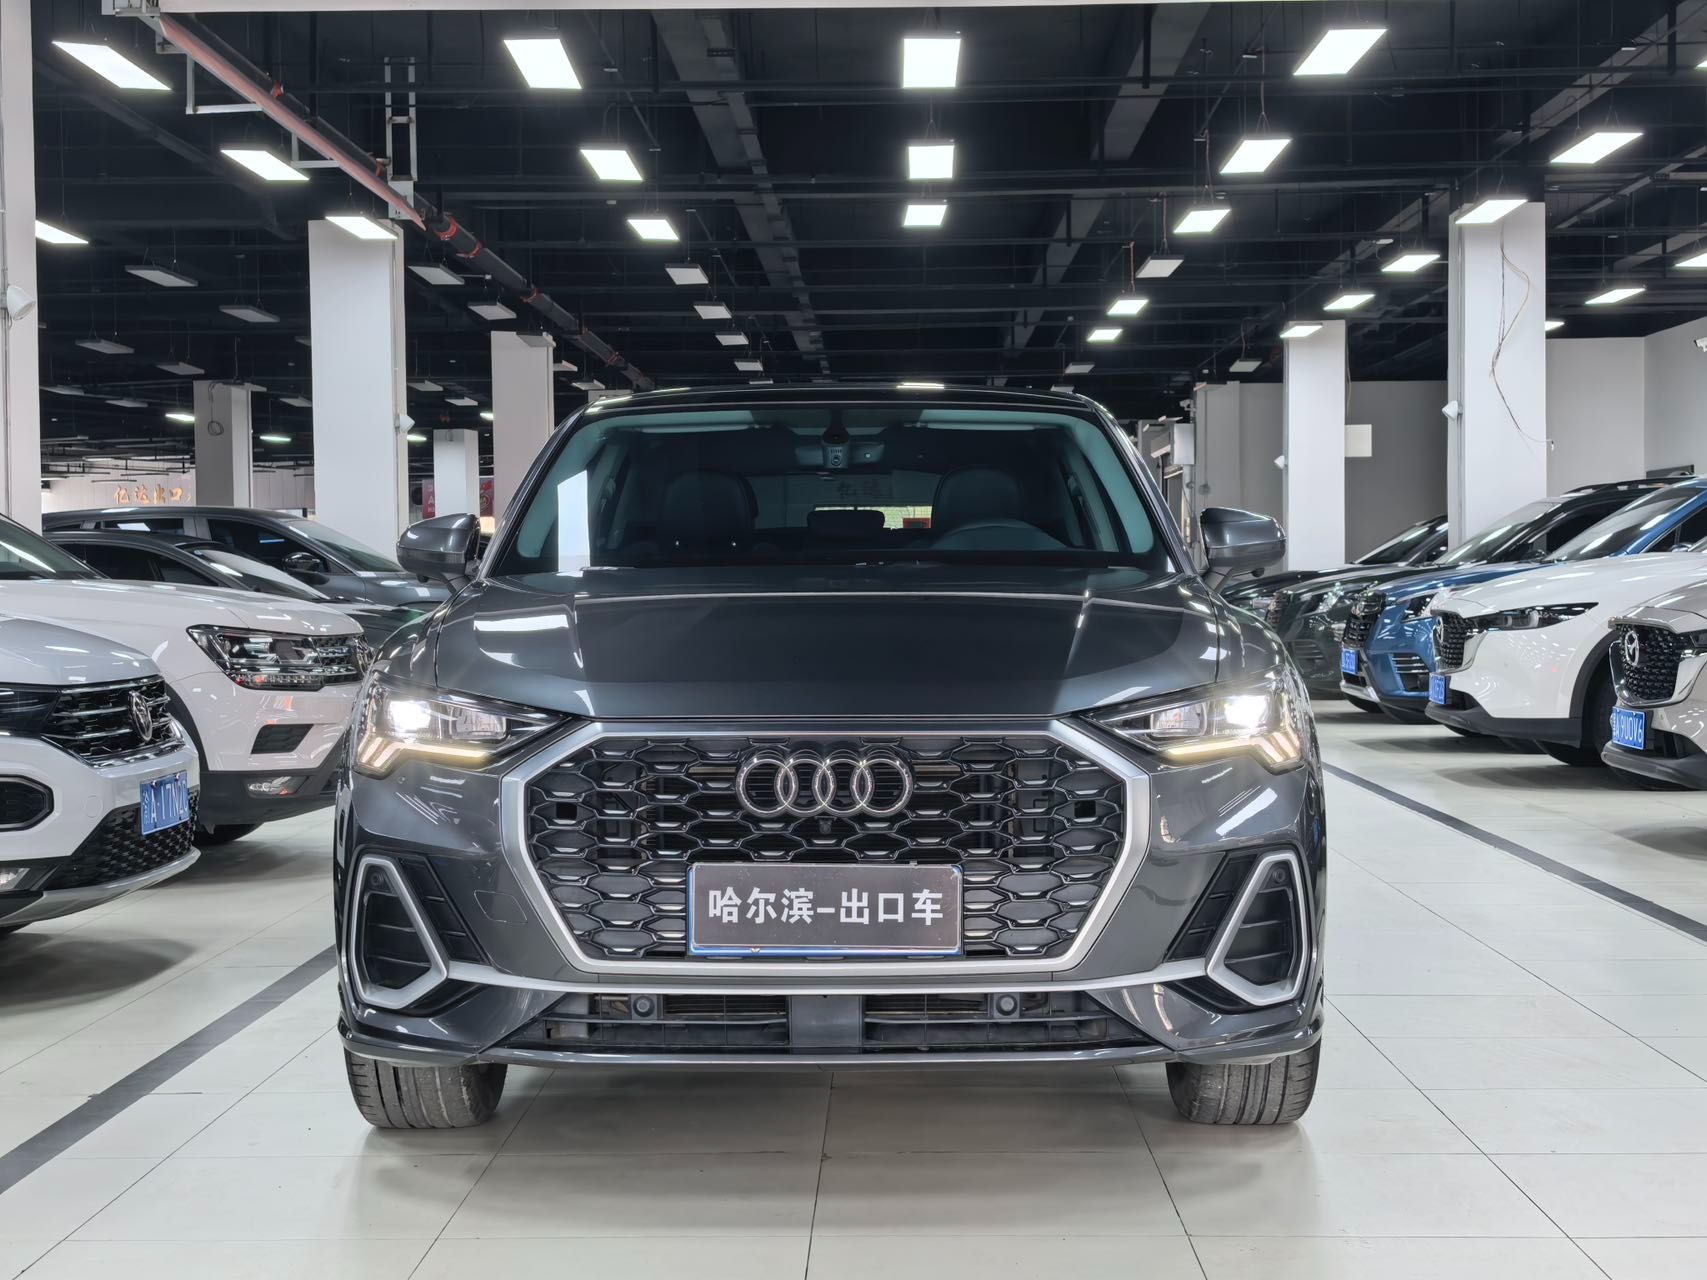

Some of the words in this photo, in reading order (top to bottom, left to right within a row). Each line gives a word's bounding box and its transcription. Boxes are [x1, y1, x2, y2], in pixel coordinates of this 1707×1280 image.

[112, 483, 192, 505] 亿达出口
[708, 886, 944, 925] 哈尔滨-出口车
